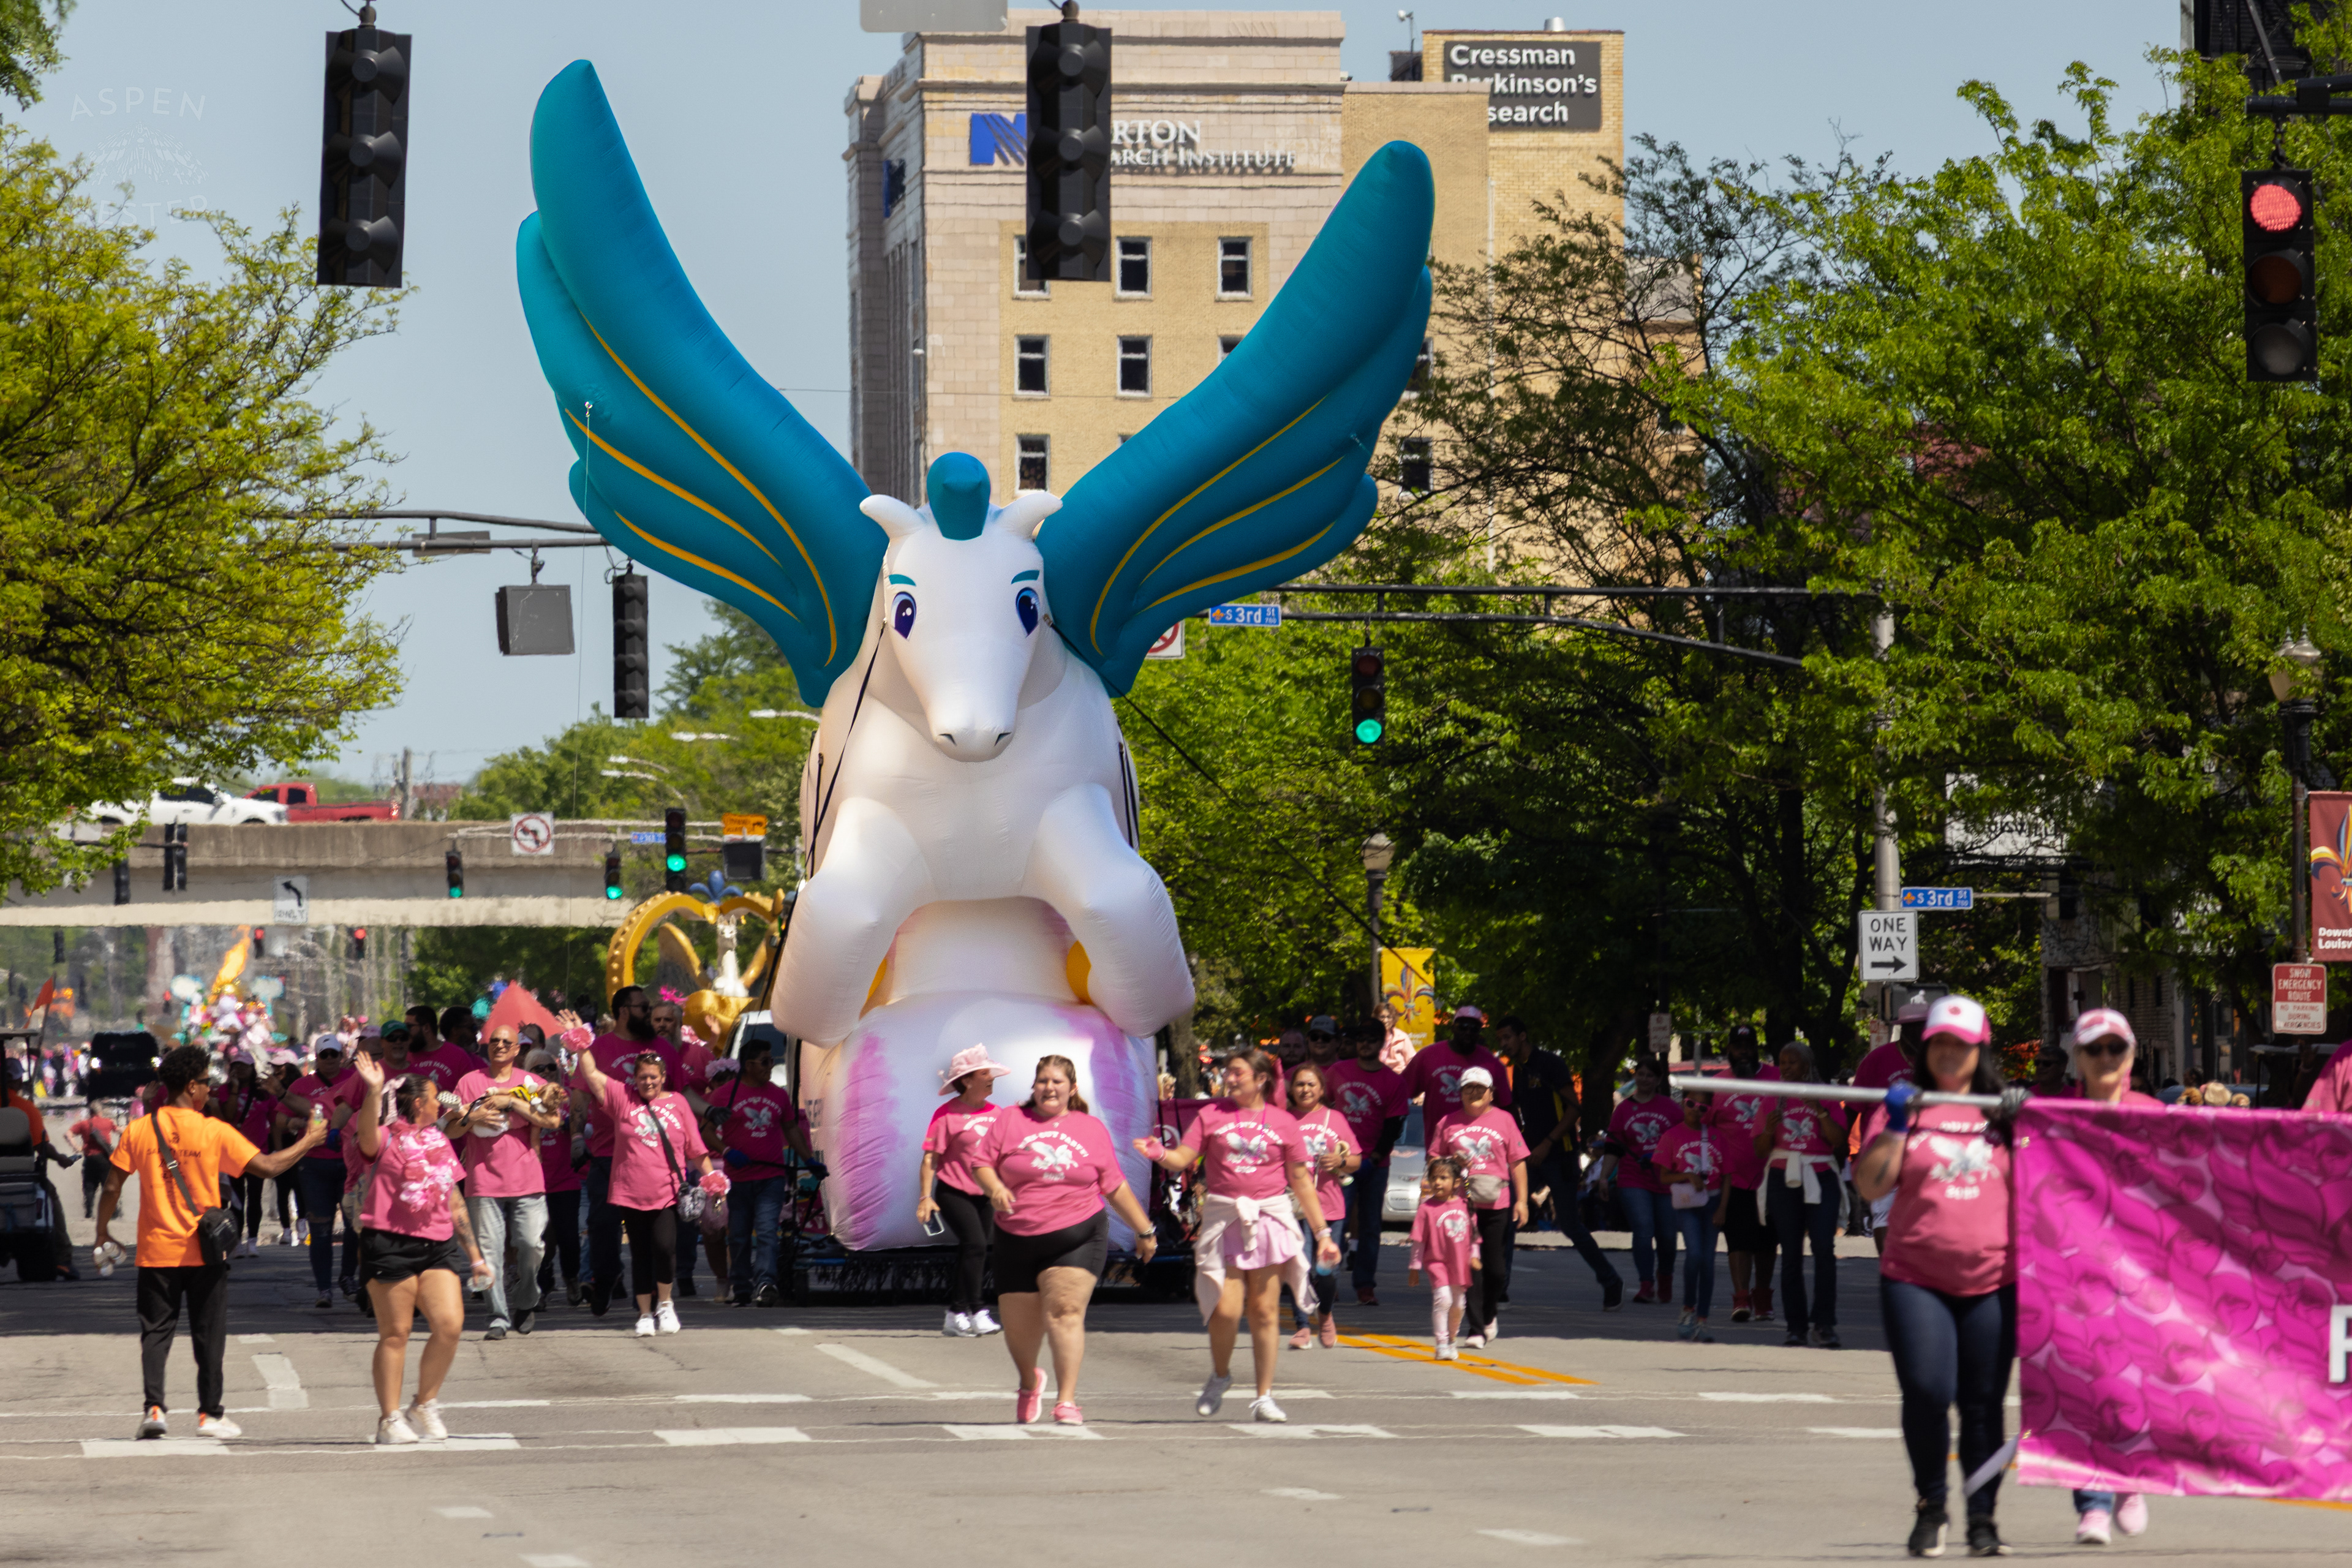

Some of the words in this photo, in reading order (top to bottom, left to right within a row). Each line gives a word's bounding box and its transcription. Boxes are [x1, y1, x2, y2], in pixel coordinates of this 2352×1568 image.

[1450, 45, 1576, 66] Cressman
[1177, 148, 1297, 167] INSTITUTE
[1226, 609, 1233, 620] S
[1235, 607, 1261, 624] 3rd
[1917, 892, 1924, 904] S
[1927, 890, 1954, 906] 3rd
[1871, 918, 1906, 932] ONE
[1869, 937, 1907, 951] WAY
[2289, 968, 2312, 978] SNOW
[2278, 979, 2322, 990] EMERGENCY
[2287, 990, 2312, 1001] ROUTE
